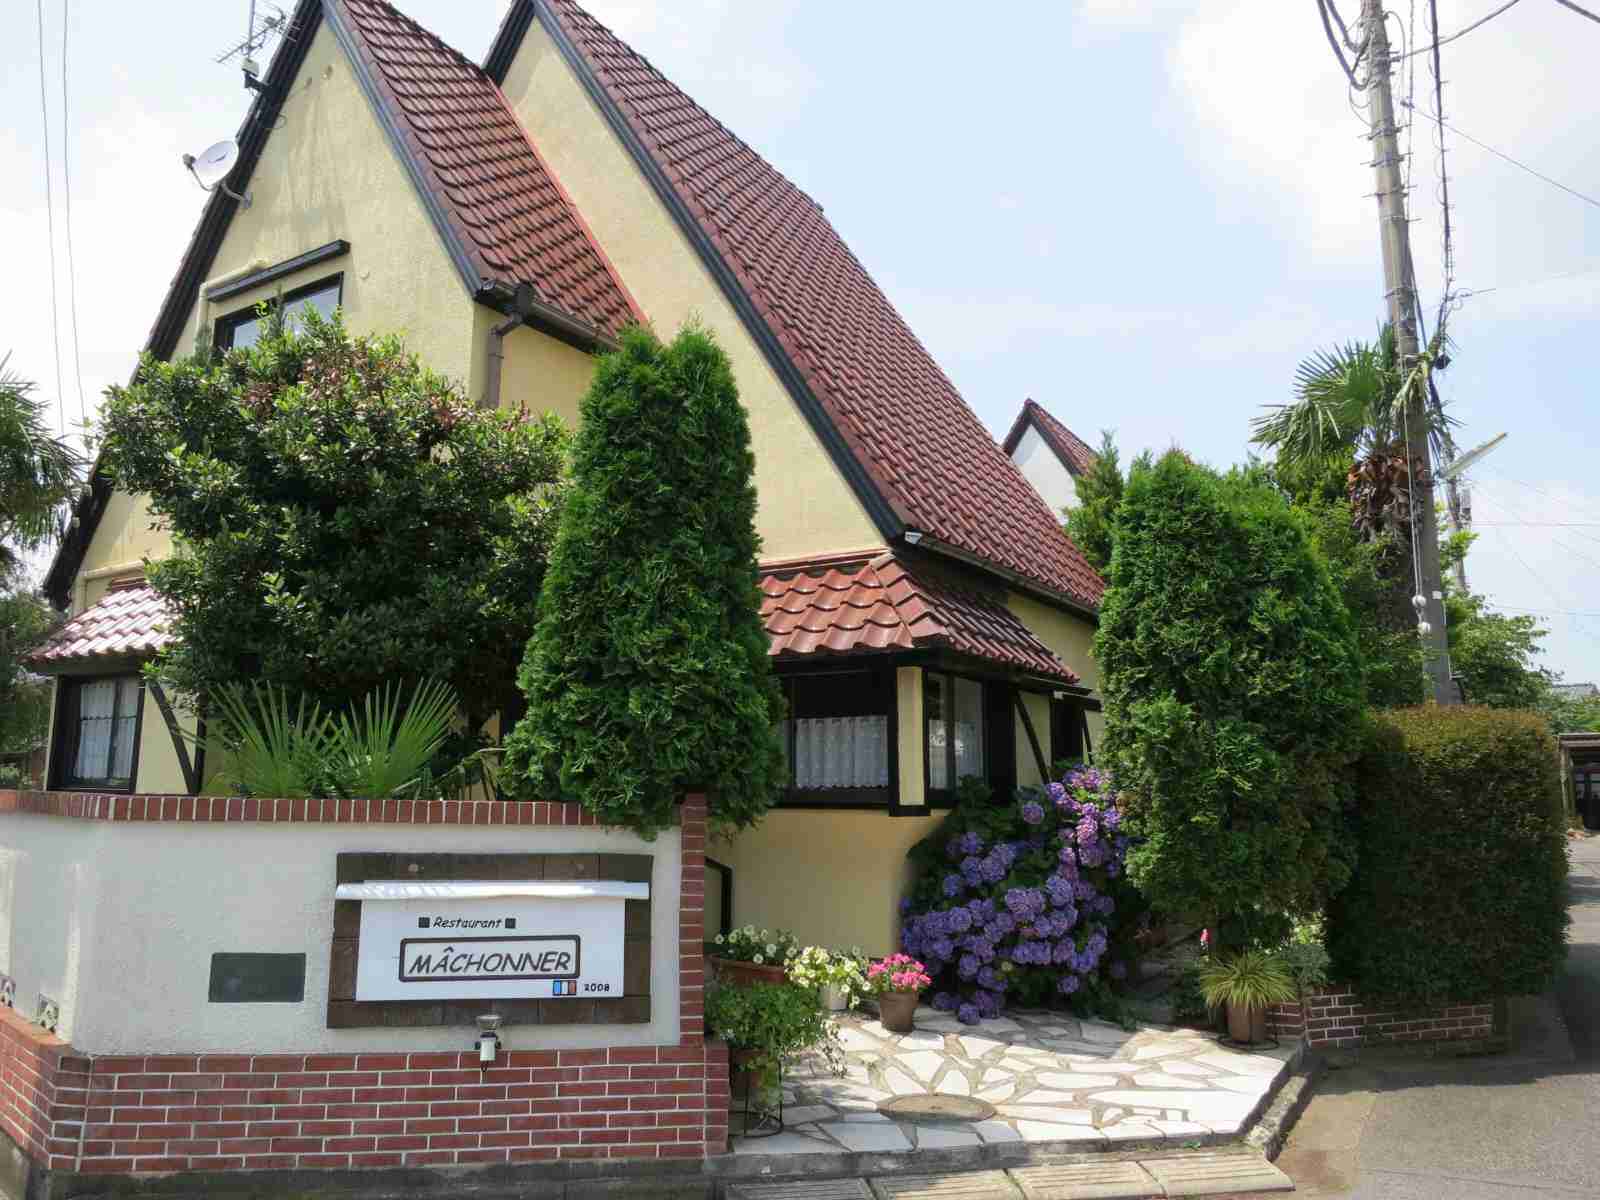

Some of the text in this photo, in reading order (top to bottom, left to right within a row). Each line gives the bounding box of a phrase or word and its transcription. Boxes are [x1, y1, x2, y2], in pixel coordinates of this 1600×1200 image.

[432, 917, 502, 929] Restaurant
[408, 946, 571, 974] MÂCHONNER
[584, 983, 610, 992] 2008
